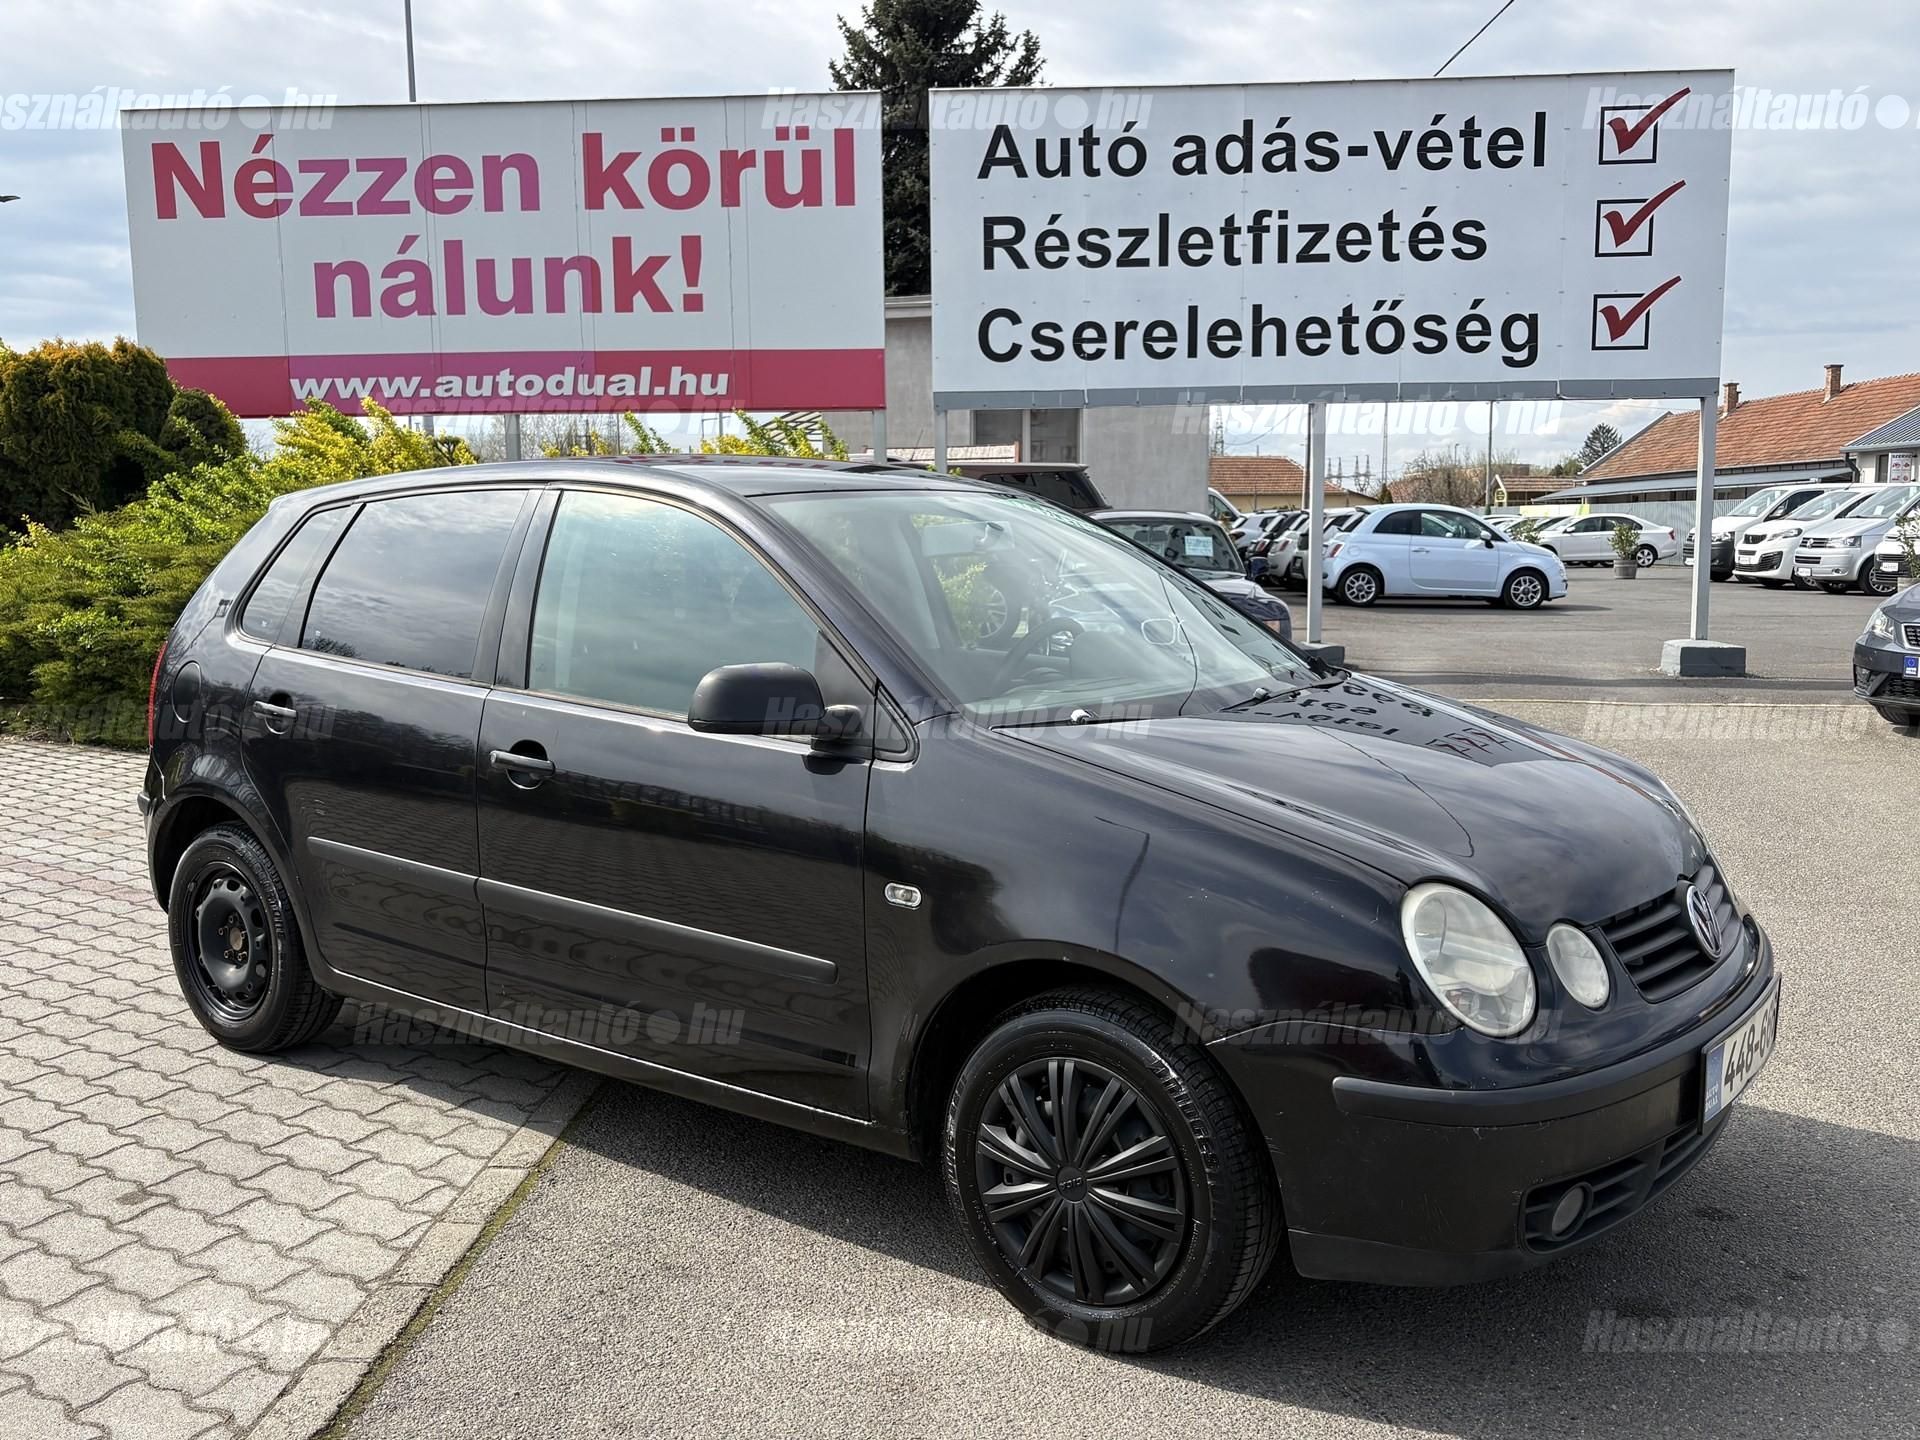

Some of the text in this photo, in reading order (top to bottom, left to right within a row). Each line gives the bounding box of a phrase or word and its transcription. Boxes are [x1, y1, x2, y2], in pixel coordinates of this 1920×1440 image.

[151, 126, 856, 220] Nézzen körül
[977, 111, 1546, 179] Autó adás-vétel
[983, 206, 1488, 271] Részletfizetés
[313, 235, 704, 319] nálunk!
[978, 298, 1539, 368] Cserelehetőség
[290, 367, 729, 400] www.autodual.hu
